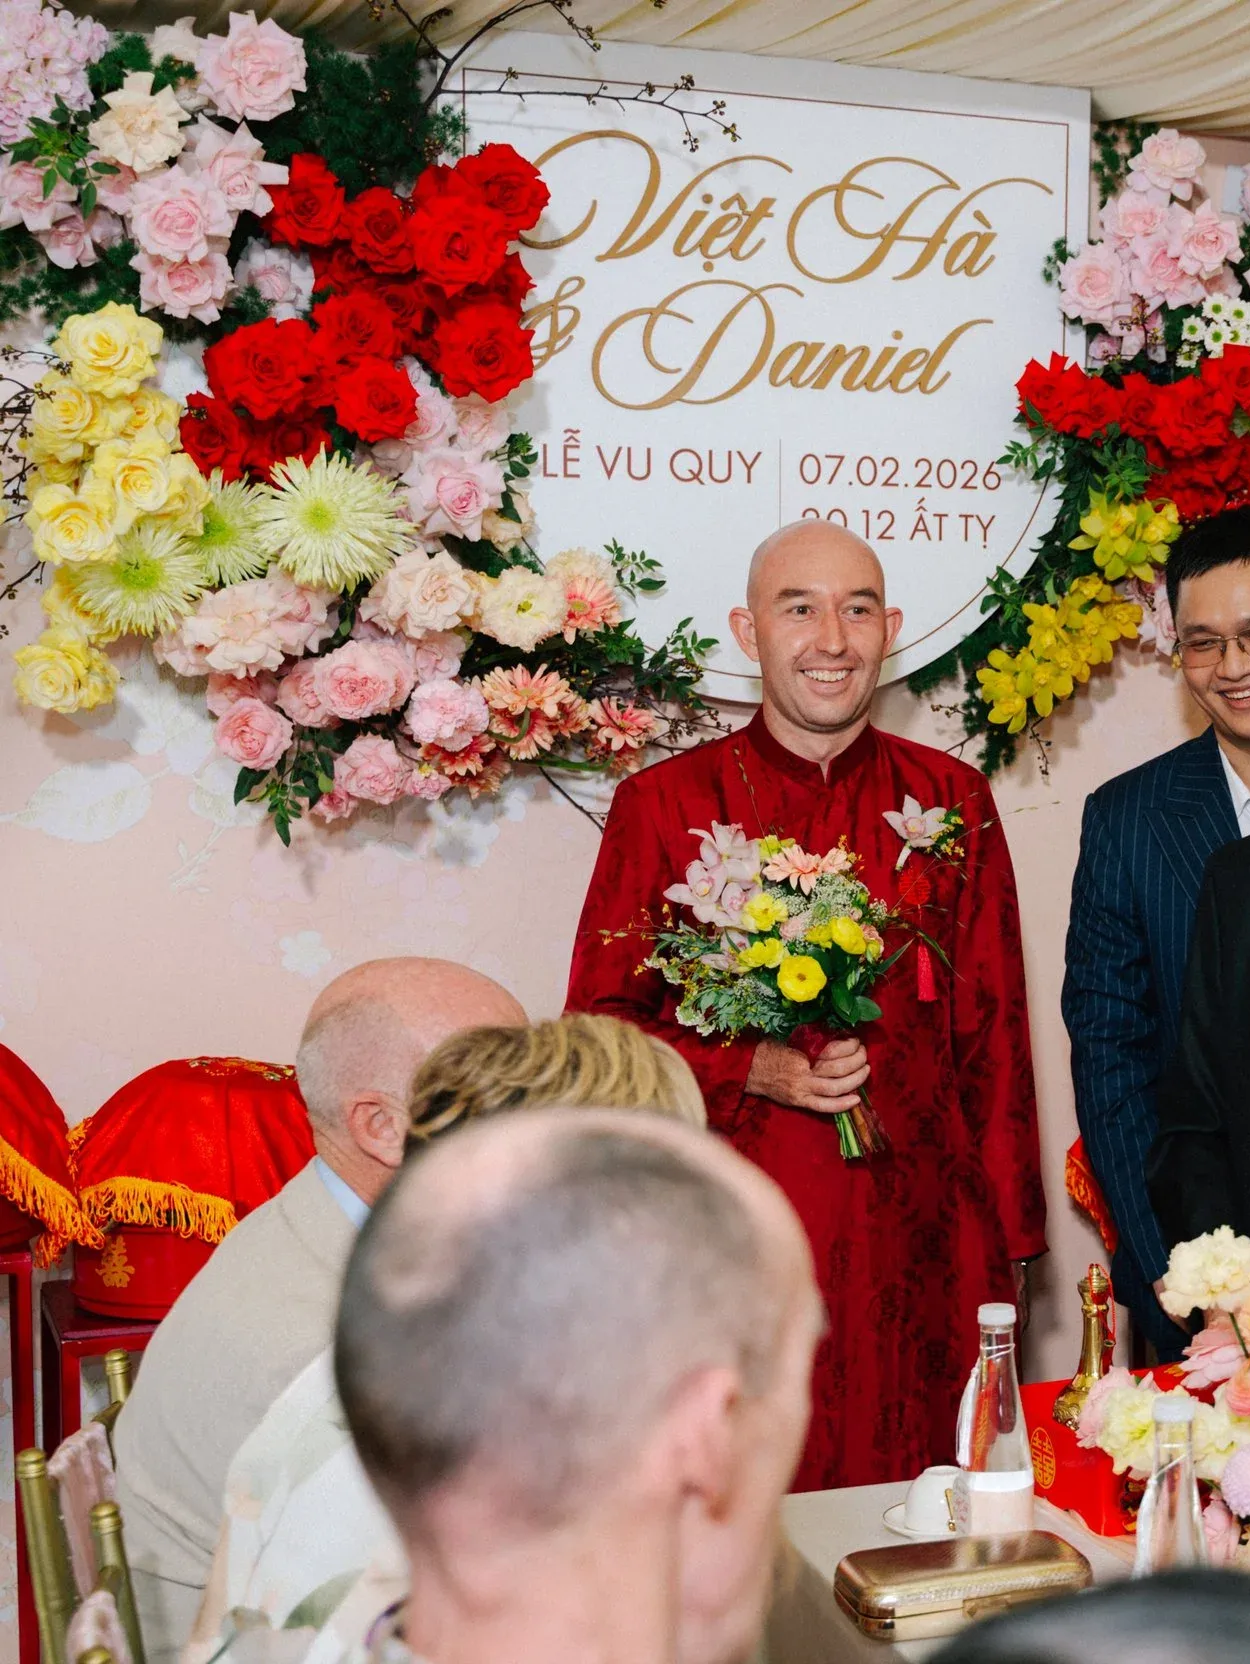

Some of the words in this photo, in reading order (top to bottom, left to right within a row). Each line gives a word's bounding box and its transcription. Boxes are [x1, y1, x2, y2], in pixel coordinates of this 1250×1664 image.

[519, 129, 793, 273] Việt
[787, 156, 1053, 284] Hà
[520, 276, 586, 371] &
[591, 279, 994, 411] Daniel
[541, 428, 582, 479] LỄ
[596, 445, 652, 481] VU
[668, 447, 762, 484] QUY
[799, 453, 1002, 491] 07.02.2026
[909, 496, 950, 542] ẤT
